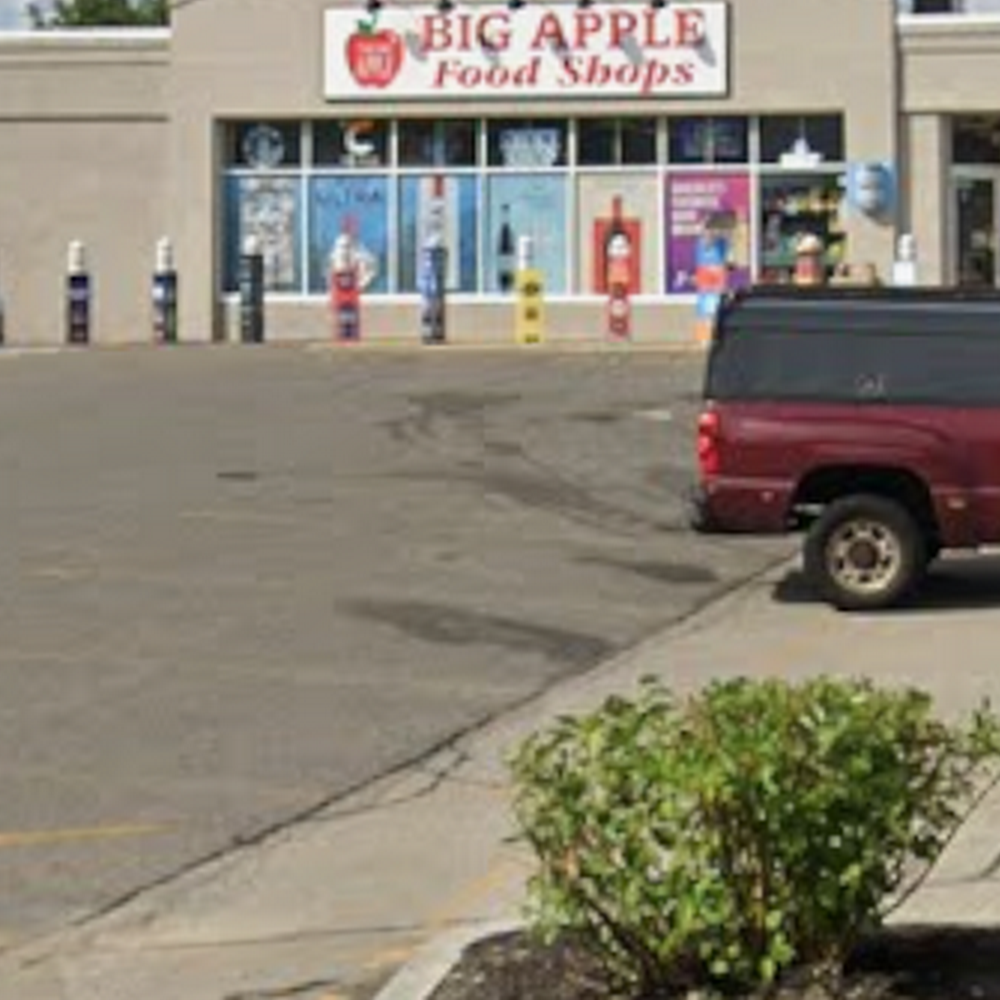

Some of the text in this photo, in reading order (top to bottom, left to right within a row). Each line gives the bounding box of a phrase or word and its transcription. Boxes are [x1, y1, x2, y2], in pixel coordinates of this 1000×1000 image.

[420, 9, 707, 51] BIG APPLE
[430, 56, 542, 89] Food
[556, 54, 696, 96] Shops
